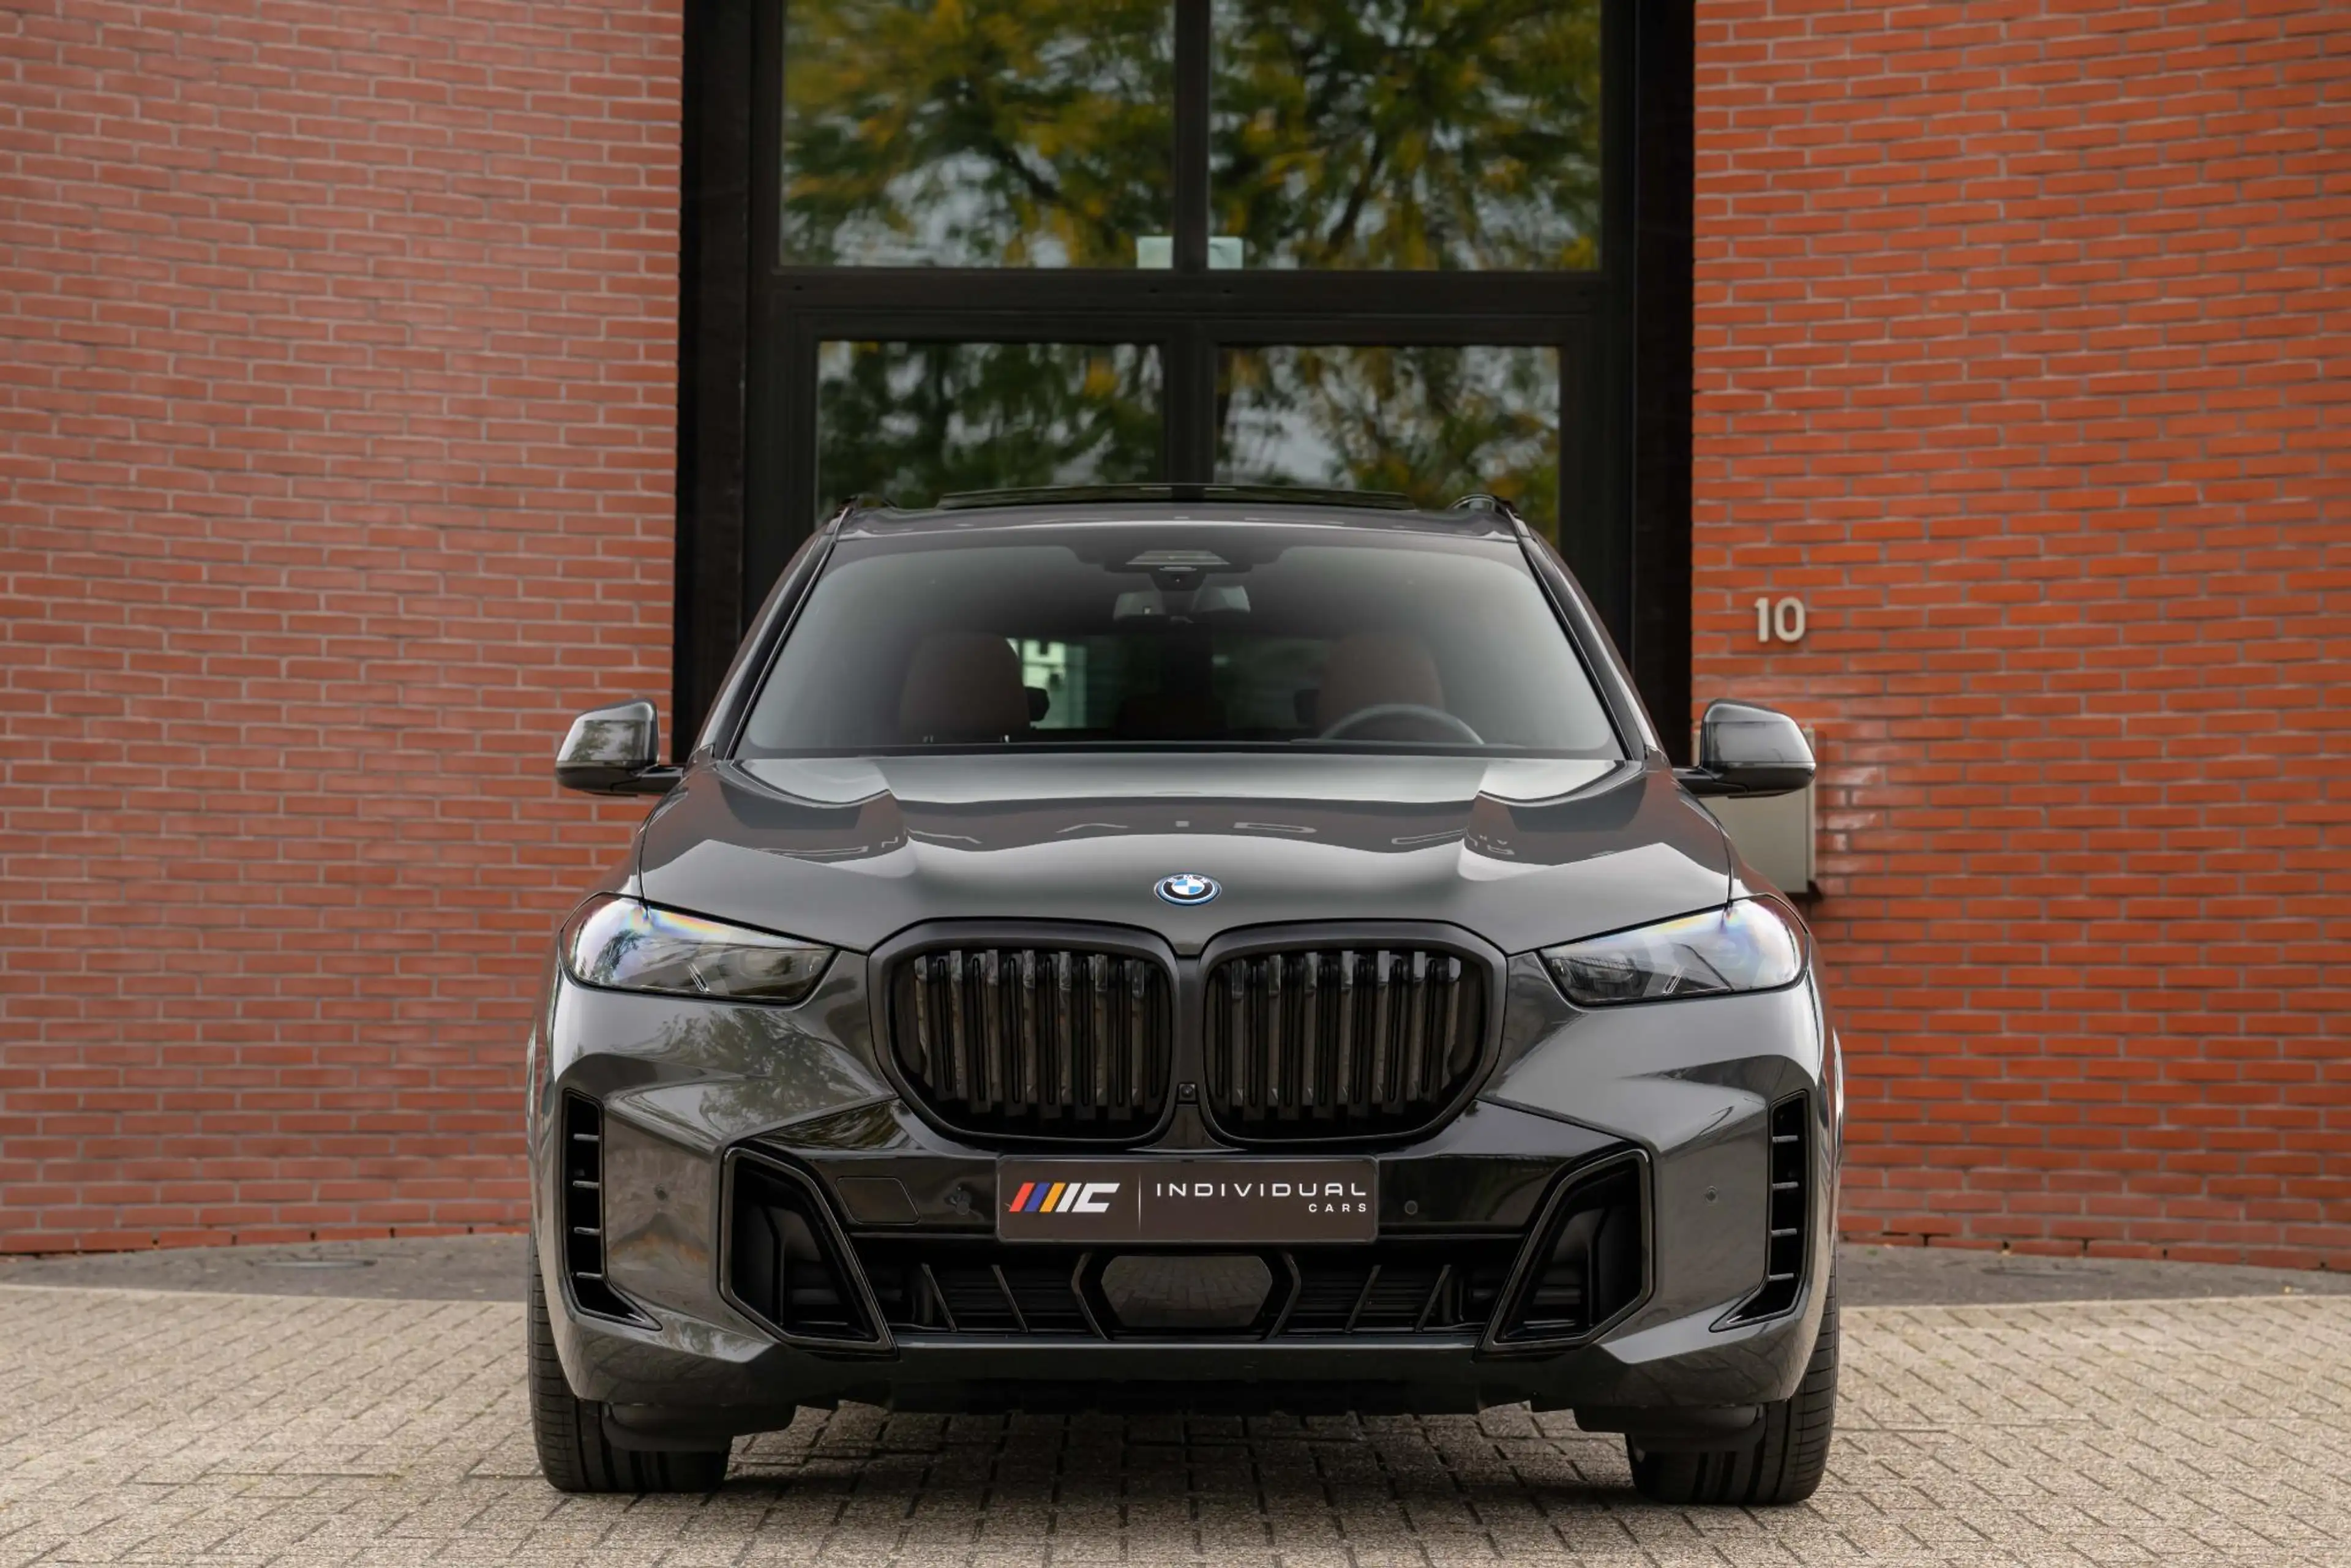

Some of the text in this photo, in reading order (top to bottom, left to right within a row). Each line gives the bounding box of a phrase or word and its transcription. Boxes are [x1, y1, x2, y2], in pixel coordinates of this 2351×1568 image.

[1754, 596, 1805, 642] 10
[1157, 1182, 1367, 1197] INDIVIDUAL
[1308, 1202, 1367, 1213] CARS
